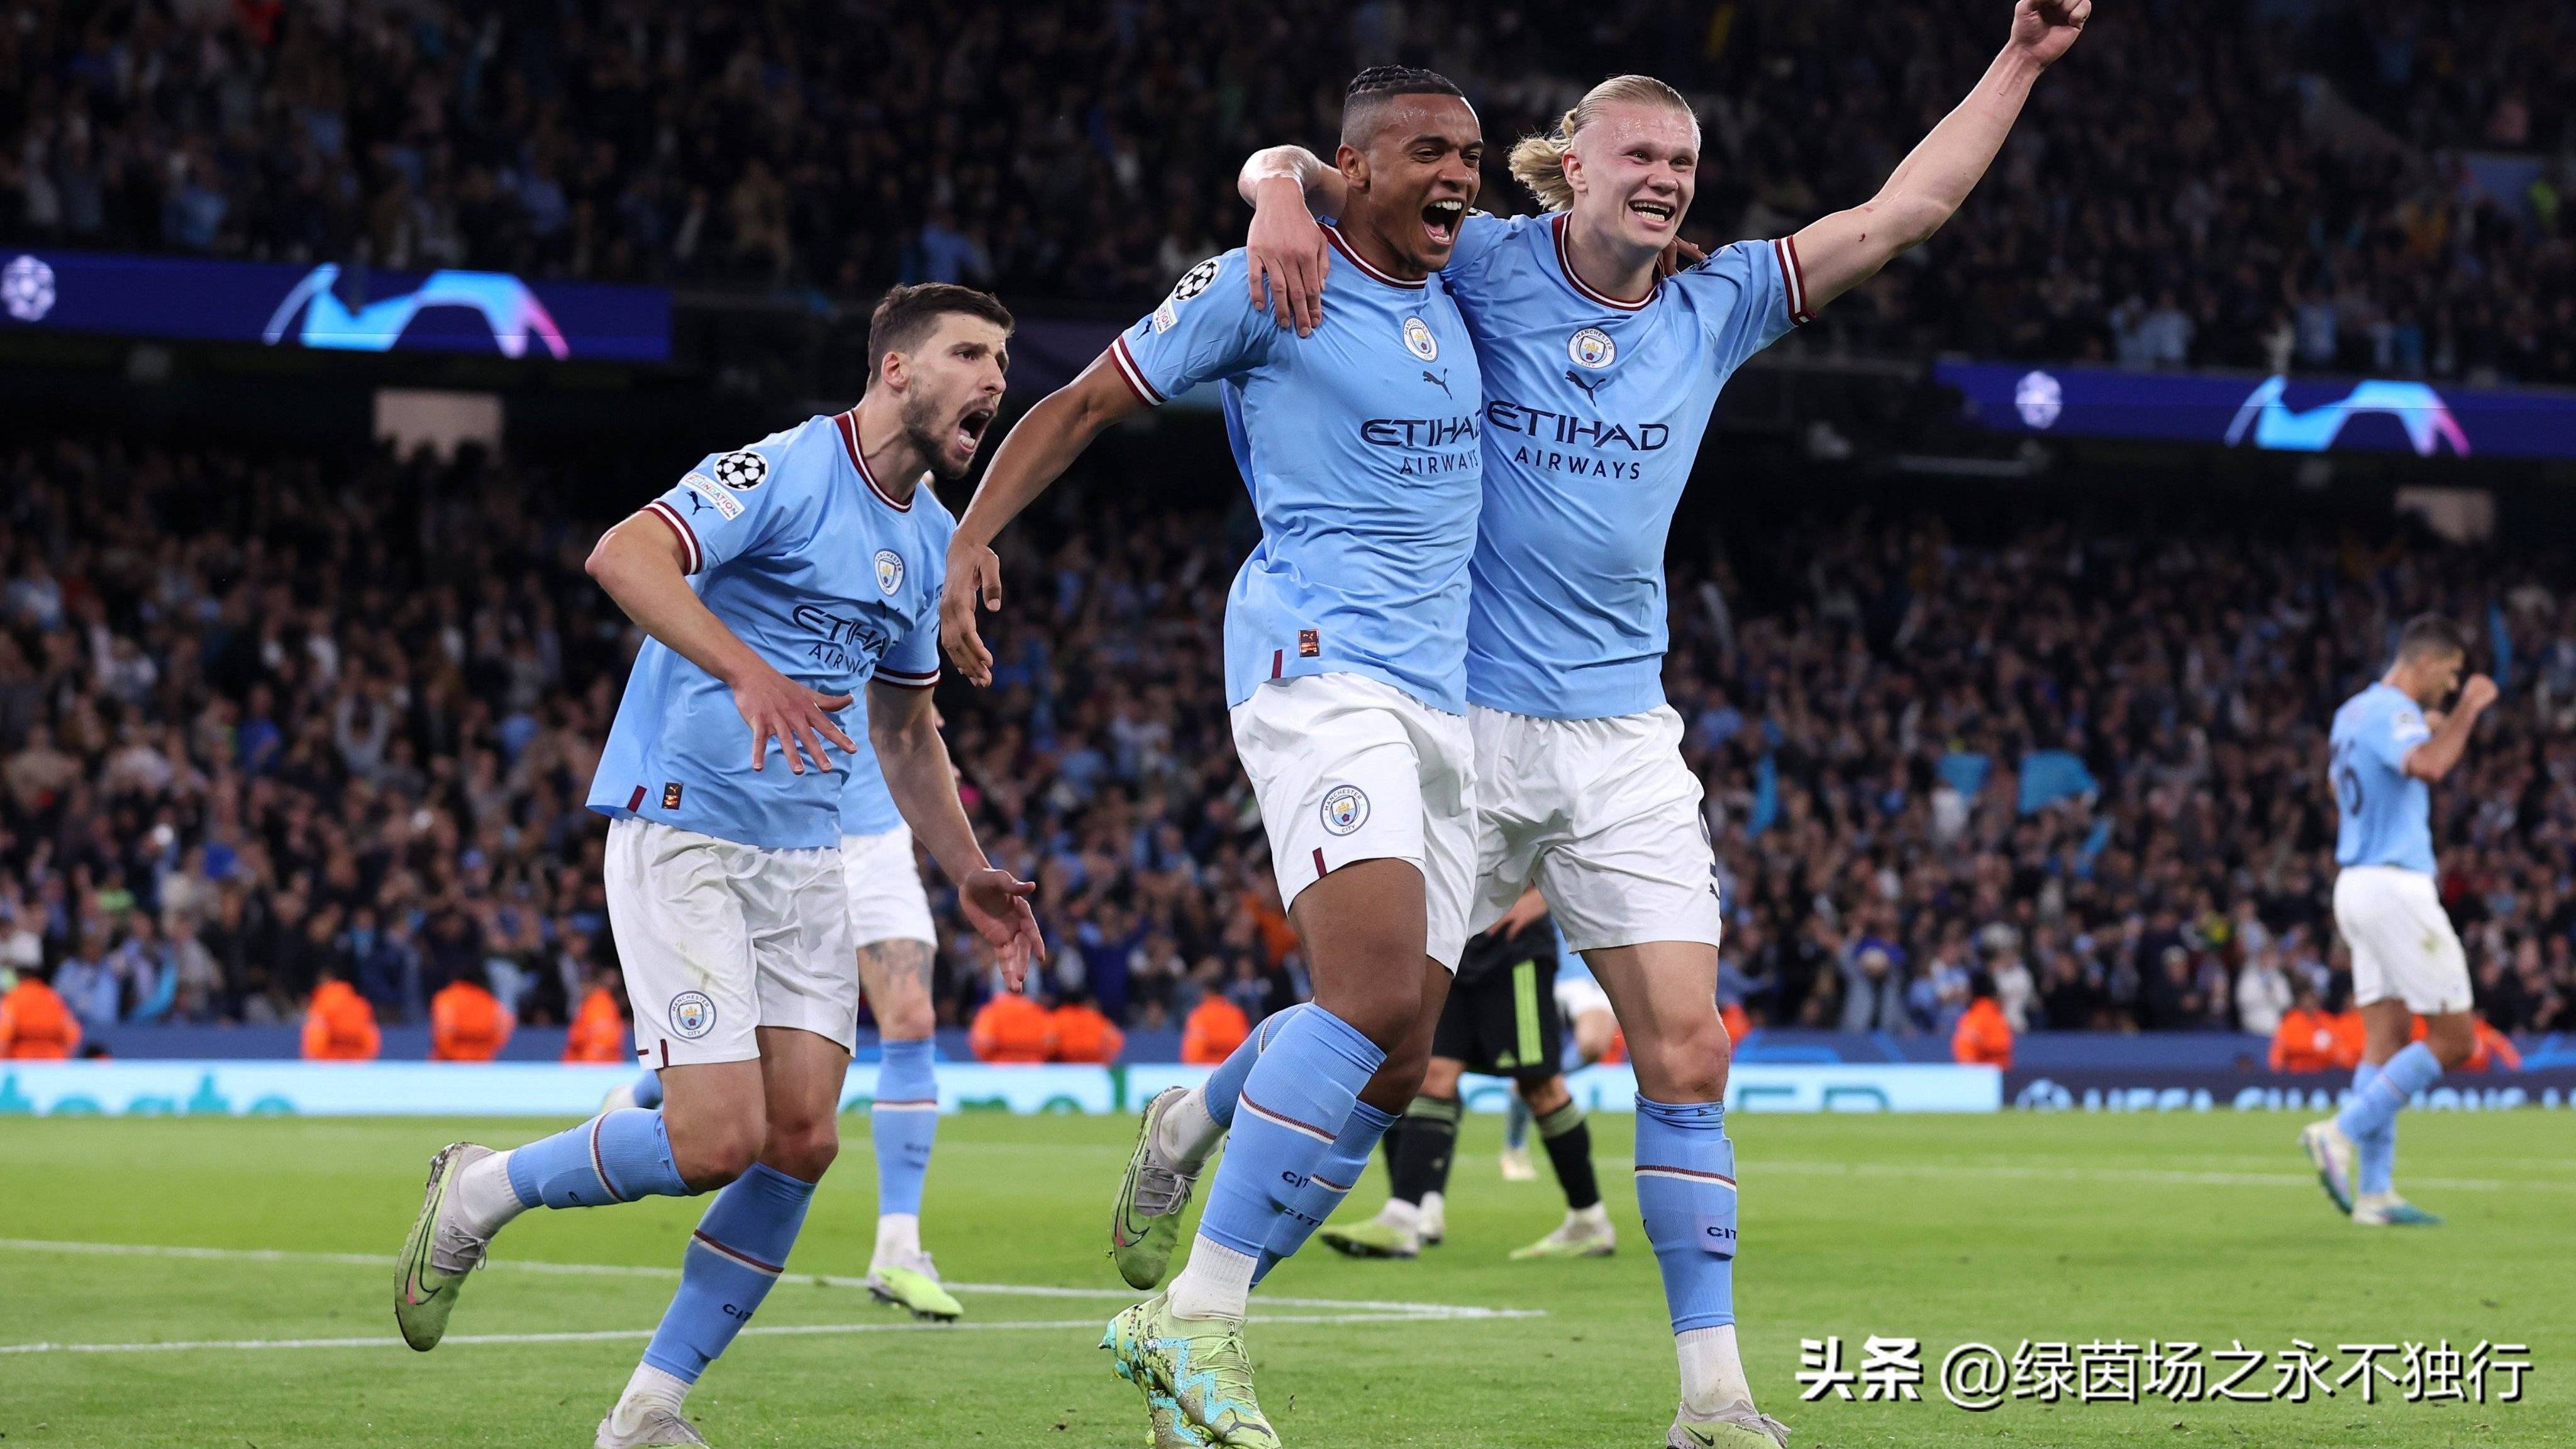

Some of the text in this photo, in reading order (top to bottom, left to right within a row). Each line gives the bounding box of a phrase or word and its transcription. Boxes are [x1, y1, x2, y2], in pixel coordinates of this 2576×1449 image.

[1575, 330, 1613, 350] MANCHESTER
[1487, 400, 1669, 451] ETIHAD
[1399, 449, 1479, 475] AIRWAYS
[1514, 446, 1640, 480] AIRWAYS
[792, 604, 899, 659] ETIHA
[1324, 789, 1362, 811] MANCHESTER
[1341, 824, 1355, 833] CITY
[672, 995, 709, 1011] MANCHESTER
[1284, 1208, 1323, 1226] CIT
